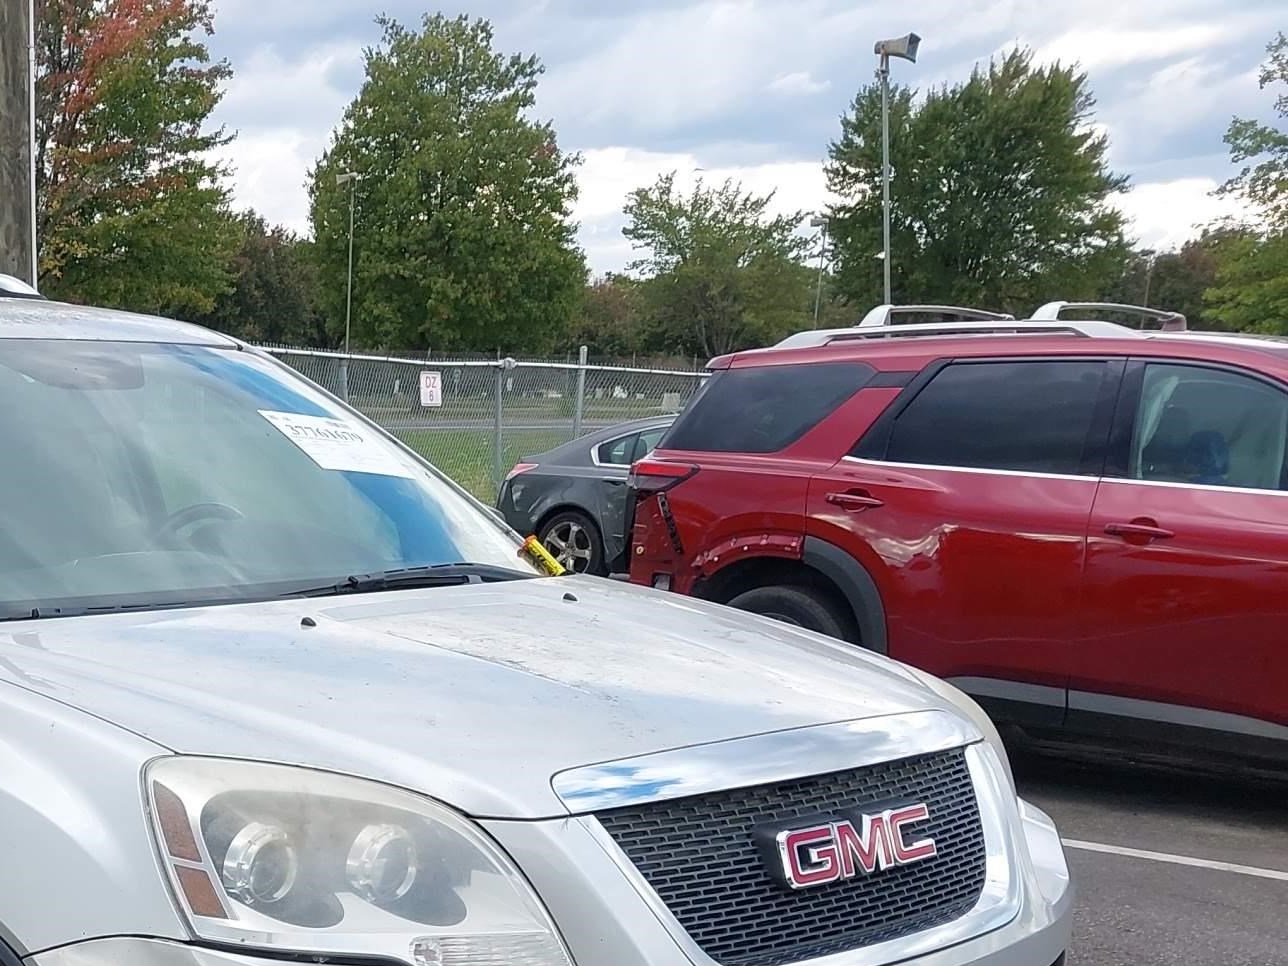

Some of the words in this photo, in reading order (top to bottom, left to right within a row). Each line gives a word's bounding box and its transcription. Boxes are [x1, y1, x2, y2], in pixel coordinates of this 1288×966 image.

[425, 375, 437, 389] DZ
[285, 423, 364, 443] 37761679
[776, 802, 937, 889] GMC
